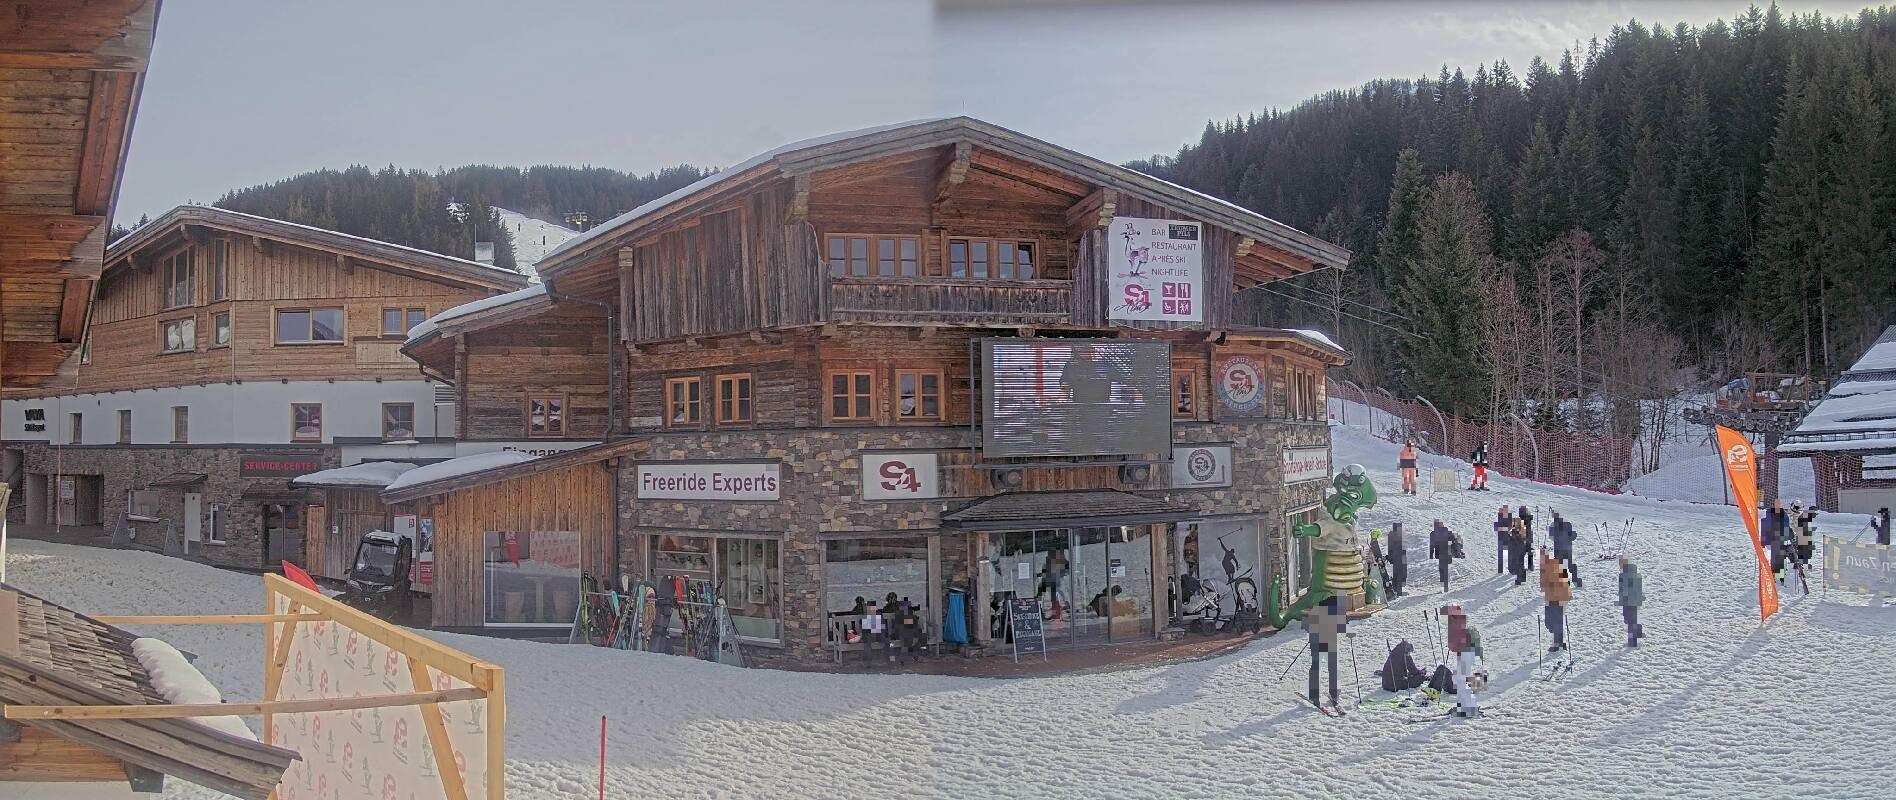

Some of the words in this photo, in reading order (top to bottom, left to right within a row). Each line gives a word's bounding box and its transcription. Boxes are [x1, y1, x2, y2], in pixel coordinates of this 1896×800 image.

[1151, 228, 1166, 236] BAR
[1151, 242, 1197, 251] RESTAURANT
[1151, 268, 1189, 277] NIGHTLIFE
[880, 461, 921, 492] S4
[643, 472, 707, 491] Freeride
[712, 472, 777, 494] Experts
